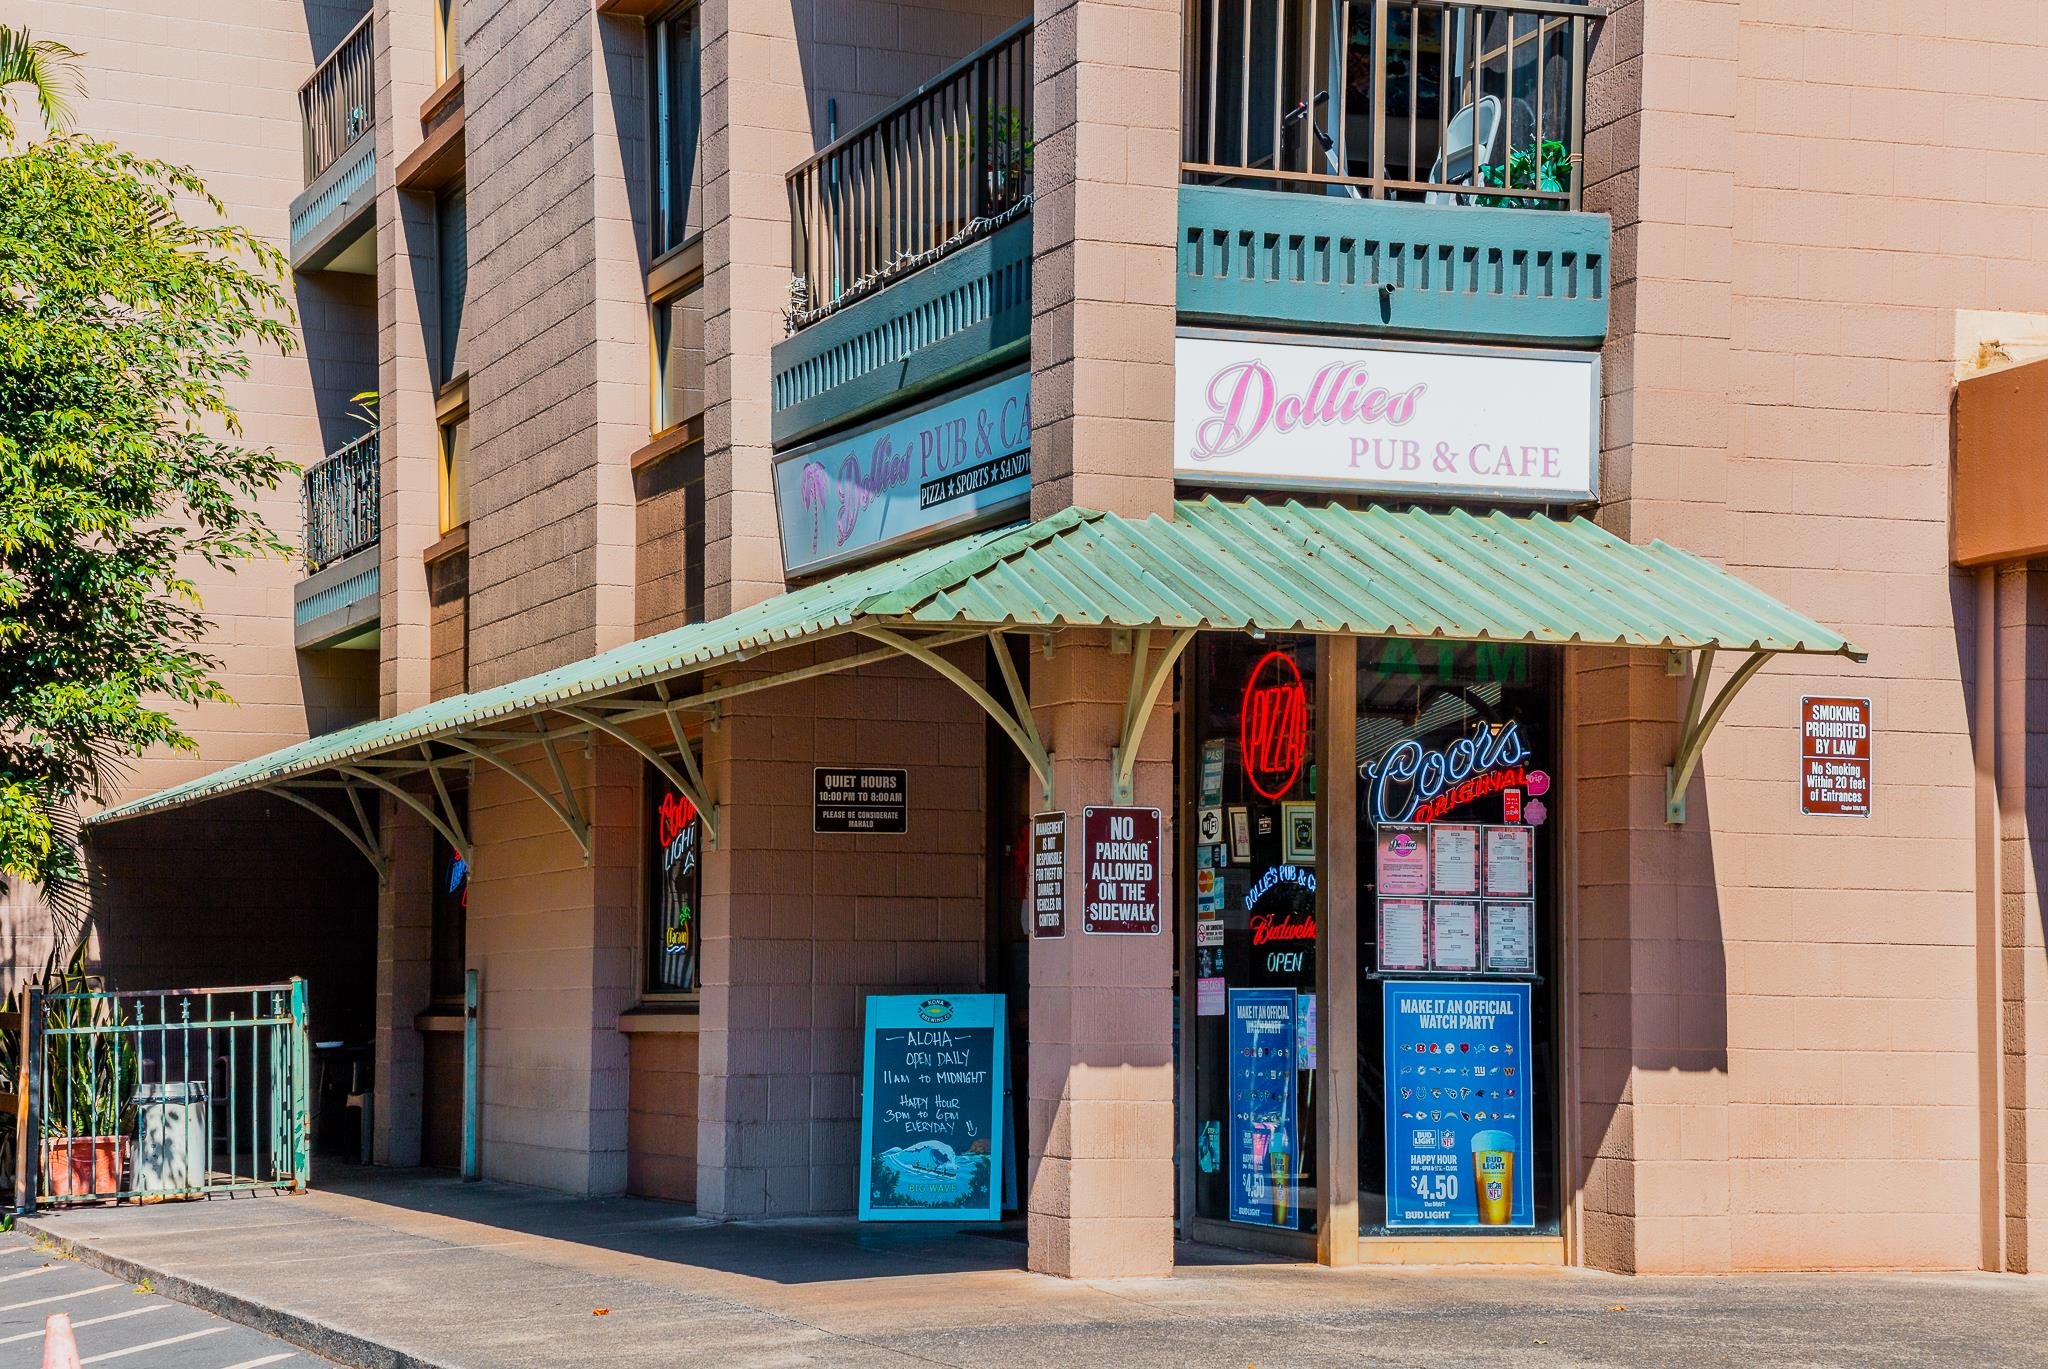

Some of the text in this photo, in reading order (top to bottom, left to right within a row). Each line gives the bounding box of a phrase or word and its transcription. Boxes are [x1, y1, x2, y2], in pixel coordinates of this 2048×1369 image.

[1190, 358, 1427, 461] Dollies
[920, 417, 968, 479] PUB
[975, 407, 994, 459] &
[1348, 437, 1561, 478] PUB & CAFE
[837, 433, 914, 546] Dollies
[921, 483, 946, 506] PIZZA
[955, 466, 989, 494] SPORTS
[1376, 637, 1527, 682] ATM
[1812, 704, 1860, 722] SMOKING
[1249, 685, 1302, 773] PIZZA
[1806, 722, 1866, 739] PROHIBITED
[1816, 739, 1856, 755] BY LAW
[1361, 720, 1531, 822] Coors
[1811, 762, 1861, 778] No Smoking
[825, 775, 897, 790] QUIET HOURS
[1807, 775, 1866, 789] Within 20 feet
[819, 791, 841, 801] 10:00
[843, 792, 856, 801] PM
[857, 792, 868, 802] TO
[1414, 767, 1529, 822] ORIGINAL
[1810, 789, 1862, 803] of Entrances
[823, 811, 899, 820] PLEASE BE CONSIDERATE
[1035, 821, 1063, 836] MANAGEMENT
[1110, 817, 1134, 840] NO
[664, 822, 696, 872] LIGHT
[1042, 837, 1056, 850] IS NOT
[1096, 842, 1148, 860] PARKING
[1036, 852, 1062, 866] RESPONSIBLE
[1035, 866, 1063, 881] FOR THEFT OR
[1092, 863, 1153, 881] ALLOWED
[1037, 882, 1061, 896] DAMAGE TO
[1098, 883, 1146, 901] ON THE
[1245, 866, 1278, 911] DOLLIE'S
[1279, 864, 1296, 881] PUB
[1298, 868, 1307, 886] &
[1036, 897, 1062, 911] VEHICLES OR
[1090, 903, 1155, 921] SIDEWALK
[1038, 913, 1059, 927] CONTENTS
[1267, 952, 1303, 972] OPEN
[1237, 1005, 1289, 1020] MAKE IT AN OFFICIAL
[1401, 999, 1513, 1015] MAKE IT AN OFFICIAL
[921, 1013, 944, 1022] BREWING
[1419, 1015, 1495, 1030] WATCH PARTY
[908, 1030, 952, 1047] ALOHA
[906, 1049, 969, 1069] OPEN DAILY
[919, 1071, 931, 1082] to
[937, 1071, 986, 1084] MIDNIGHT
[900, 1094, 960, 1110] HAPPY HOUR
[918, 1110, 928, 1118] to
[905, 1121, 954, 1135] EVERYDAY
[1414, 1137, 1435, 1145] LIGHT
[1442, 1138, 1453, 1147] NFL
[1411, 1154, 1457, 1165] HAPPY HOUR
[1482, 1162, 1505, 1170] LIGHT
[909, 1183, 957, 1193] BIG WAVE
[1242, 1173, 1265, 1198] $4.50
[1411, 1174, 1458, 1200] $4.50
[1489, 1189, 1501, 1198] NFL
[1238, 1207, 1260, 1216] BUD LIGHT
[1405, 1211, 1450, 1219] BUD LIGHT
